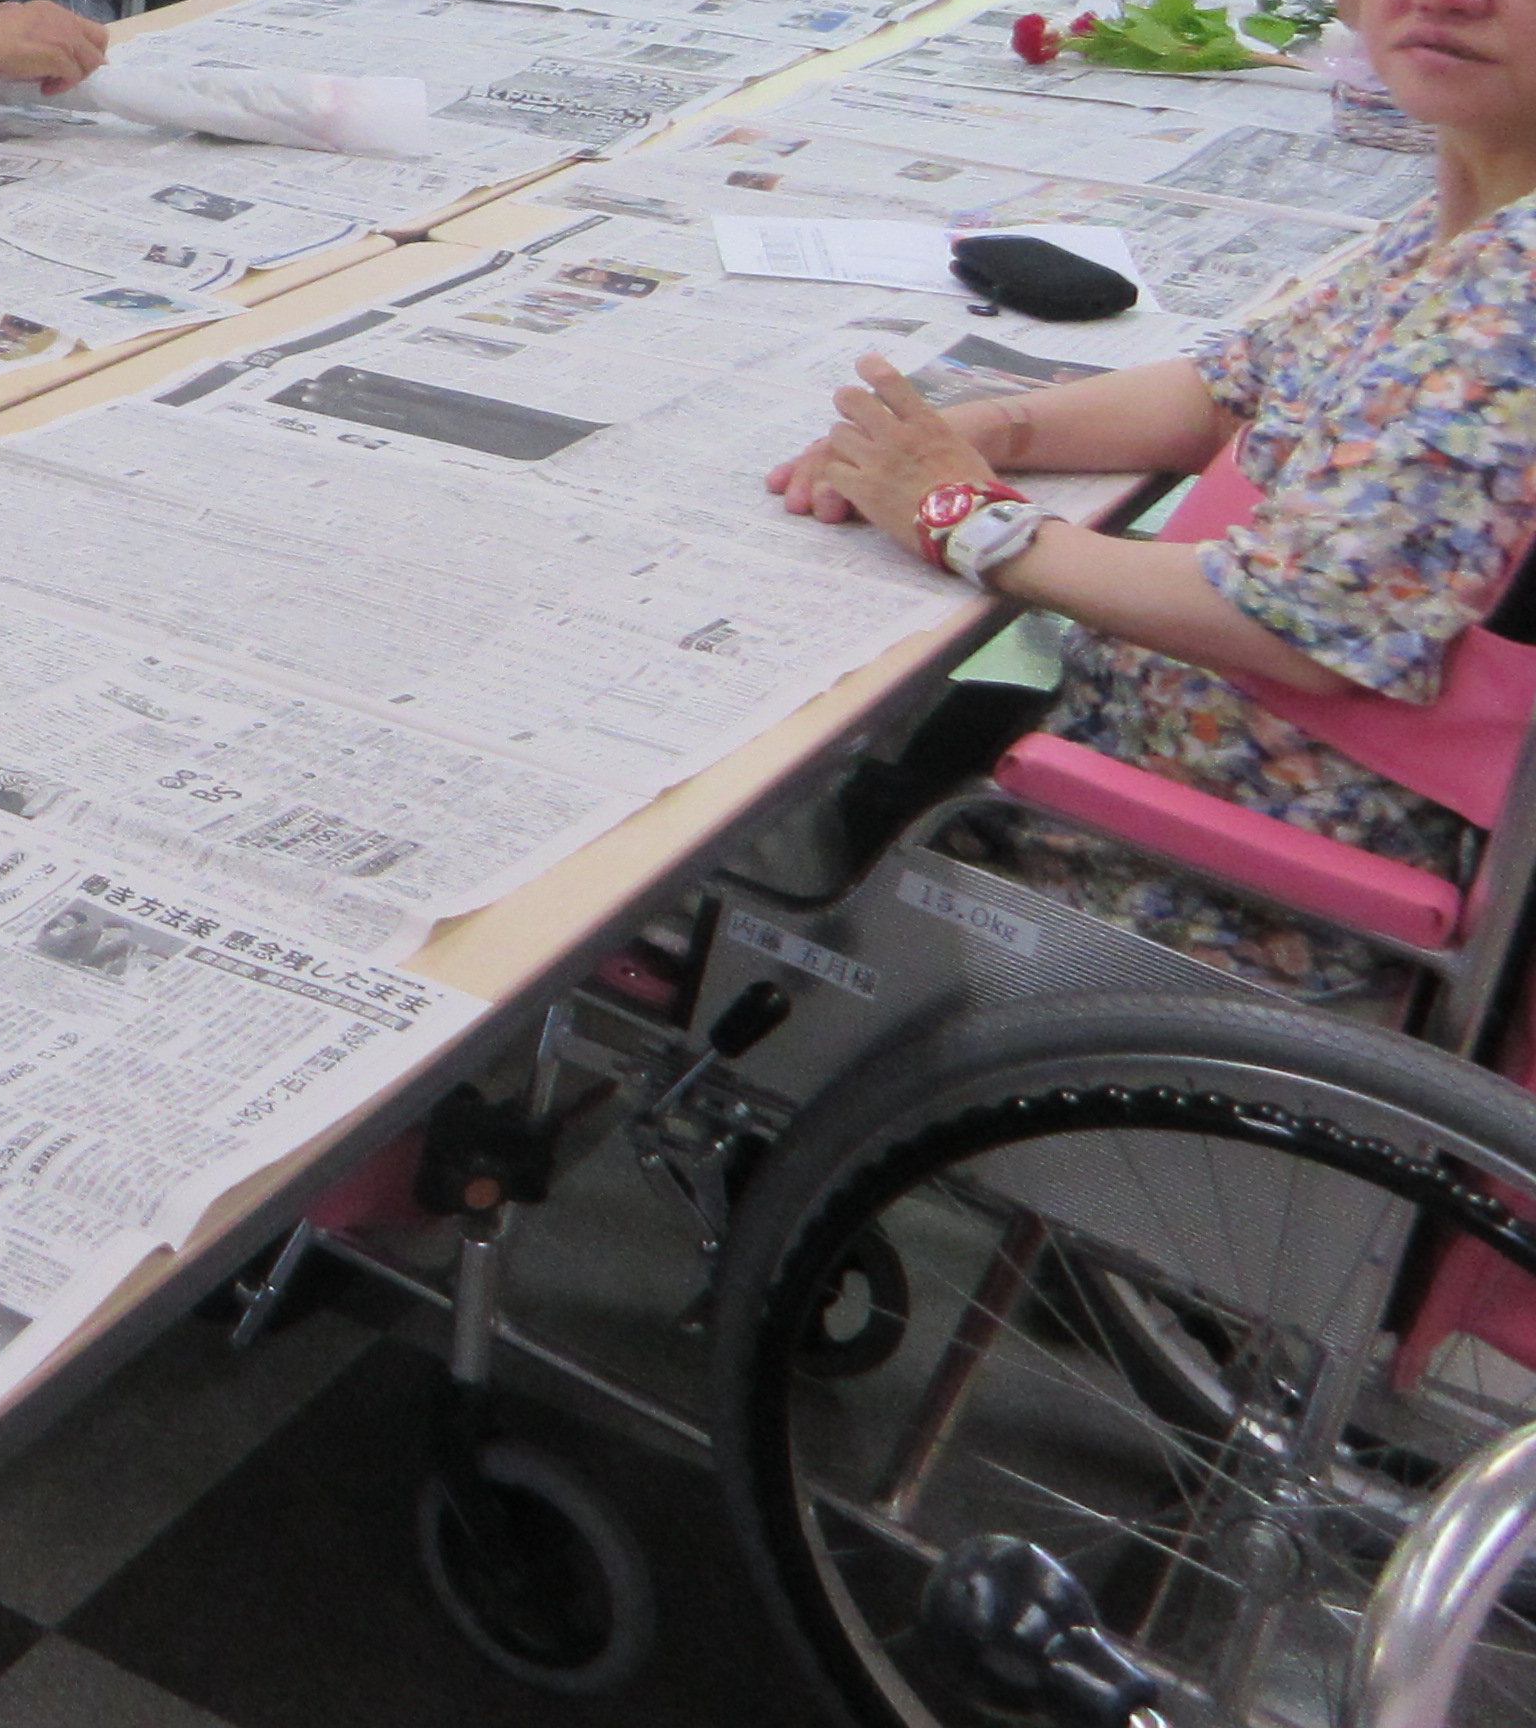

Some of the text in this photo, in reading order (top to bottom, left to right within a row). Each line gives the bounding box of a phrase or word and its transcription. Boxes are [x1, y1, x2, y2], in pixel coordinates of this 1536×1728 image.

[79, 873, 221, 939] 働き方法案
